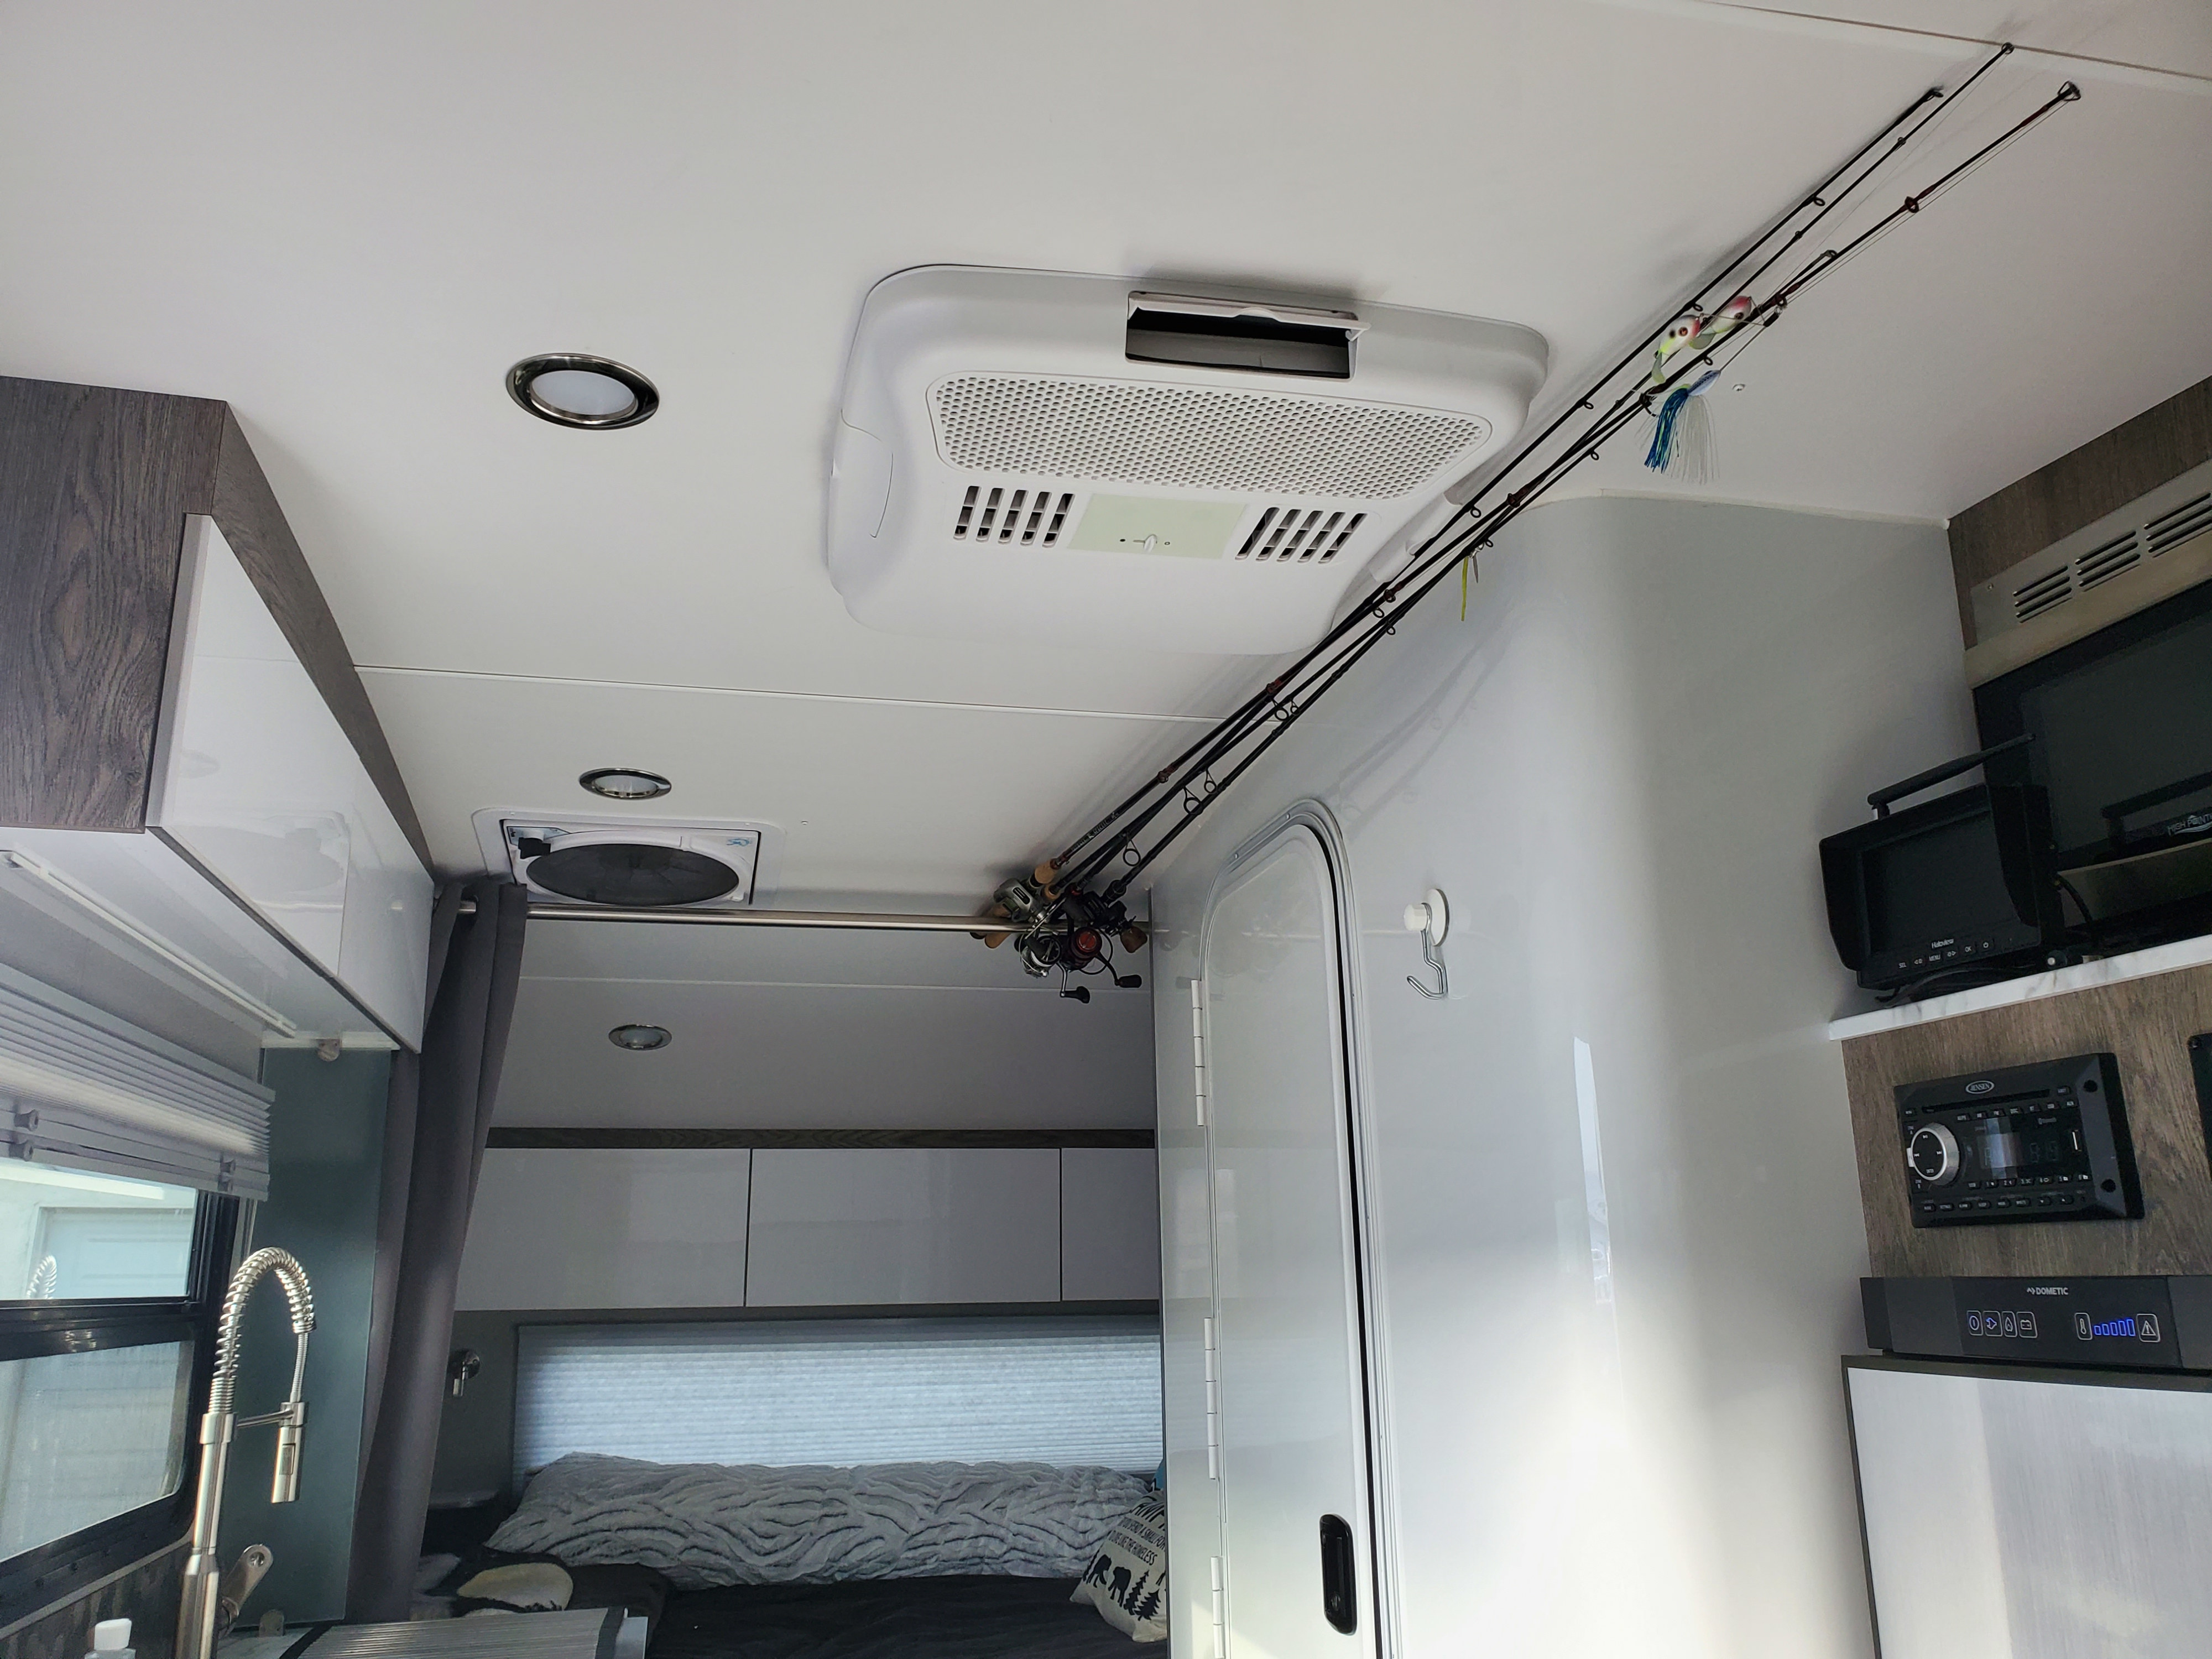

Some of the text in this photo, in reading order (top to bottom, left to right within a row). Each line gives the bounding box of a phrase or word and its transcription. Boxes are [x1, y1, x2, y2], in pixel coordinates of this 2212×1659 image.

[1932, 938, 1954, 948] Haloview
[1970, 1083, 1991, 1091] JENSEN
[2036, 1287, 2068, 1295] DOMETIC
[1131, 1543, 1158, 1566] HOMELESS
